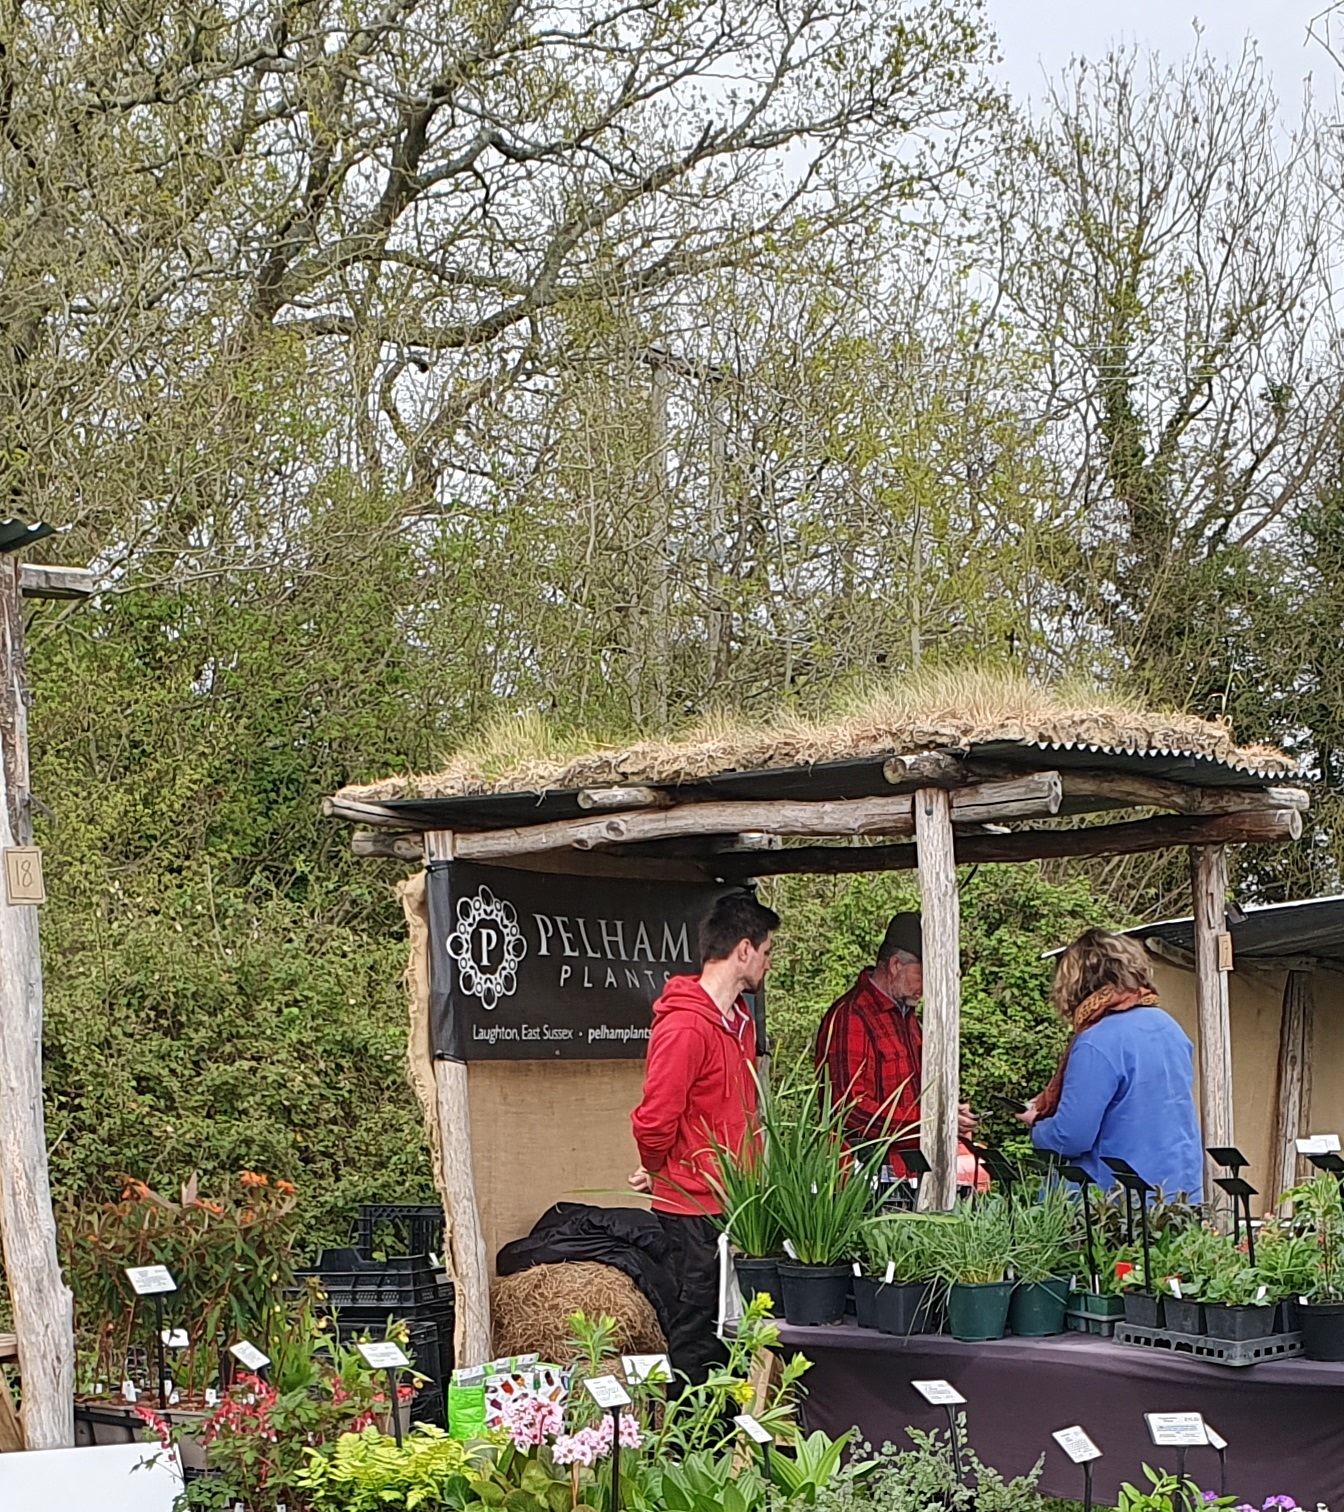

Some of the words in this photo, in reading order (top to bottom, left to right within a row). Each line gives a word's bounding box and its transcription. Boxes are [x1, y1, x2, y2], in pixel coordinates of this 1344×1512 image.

[479, 928, 497, 967] P
[532, 913, 693, 963] PELHAM
[473, 1024, 520, 1044] Laughton,
[521, 1024, 541, 1040] East
[543, 1024, 573, 1040] Sussex
